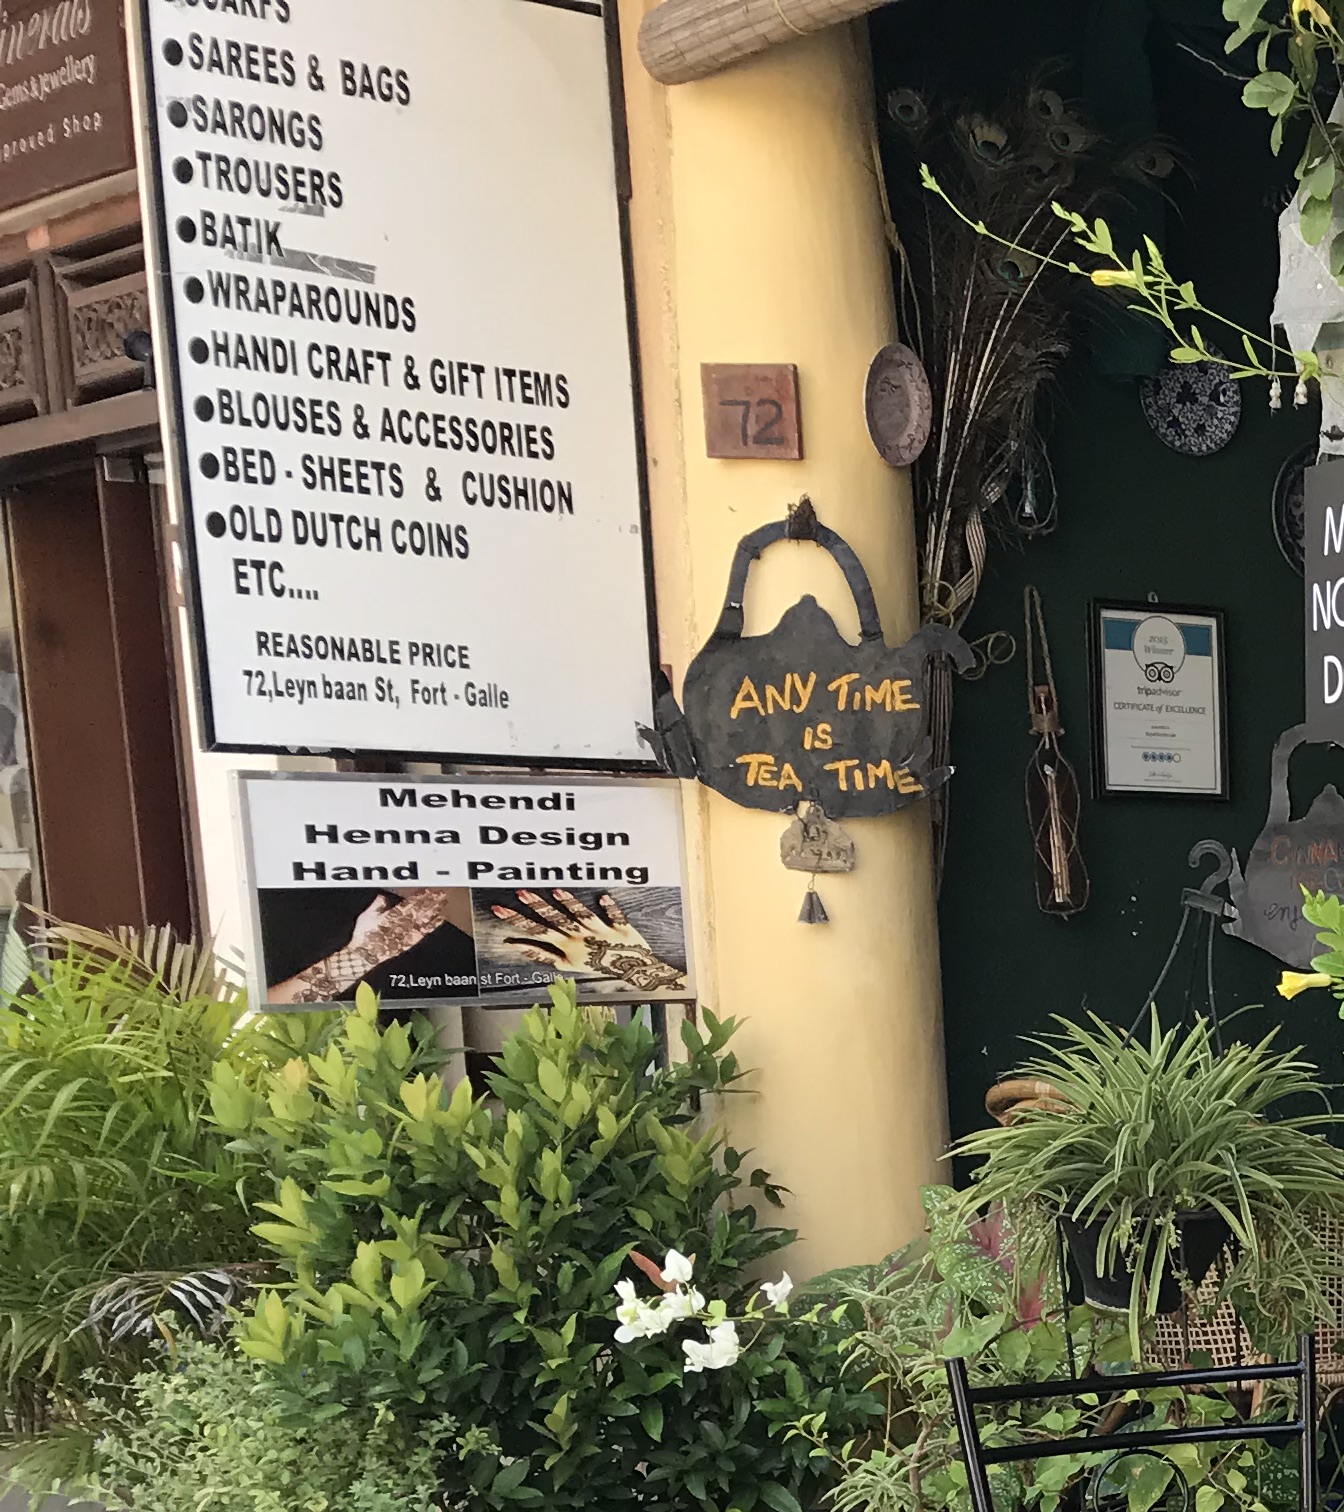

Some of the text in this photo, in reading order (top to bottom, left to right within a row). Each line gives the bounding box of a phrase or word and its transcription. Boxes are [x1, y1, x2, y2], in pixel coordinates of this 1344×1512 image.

[186, 0, 291, 23] ARFS
[187, 32, 411, 106] SAREES & BAGS
[192, 94, 324, 151] SARONGS
[195, 150, 344, 209] TROUSERS
[201, 210, 285, 258] BATIK
[206, 268, 417, 333] WRAPAROUNDS
[211, 330, 571, 410] HANDI CRAFT & GIFT ITEMS
[218, 388, 556, 461] BLOUSES & ACCESSORIES
[719, 399, 785, 447] 72
[221, 445, 574, 516] BED SHEETS & CUSHION
[229, 503, 470, 560] OLD DUTCH COINS
[255, 630, 471, 669] REASONABLE PRICE
[321, 674, 368, 703] baan
[374, 680, 400, 709] St,
[410, 681, 448, 707] Fort
[464, 683, 510, 710] Galle
[730, 671, 920, 719] ANY TIME
[1113, 702, 1206, 715] CERTIFICATE of EXCELLENCE
[1136, 686, 1182, 697] tripadvisor
[803, 723, 833, 750] IS
[736, 753, 924, 793] TEA TIME
[378, 787, 576, 813] Mehendi
[304, 823, 630, 849] Henna Design
[292, 860, 650, 886] Hand Painting
[445, 973, 477, 987] baan
[480, 973, 492, 985] st
[495, 972, 521, 985] Fort
